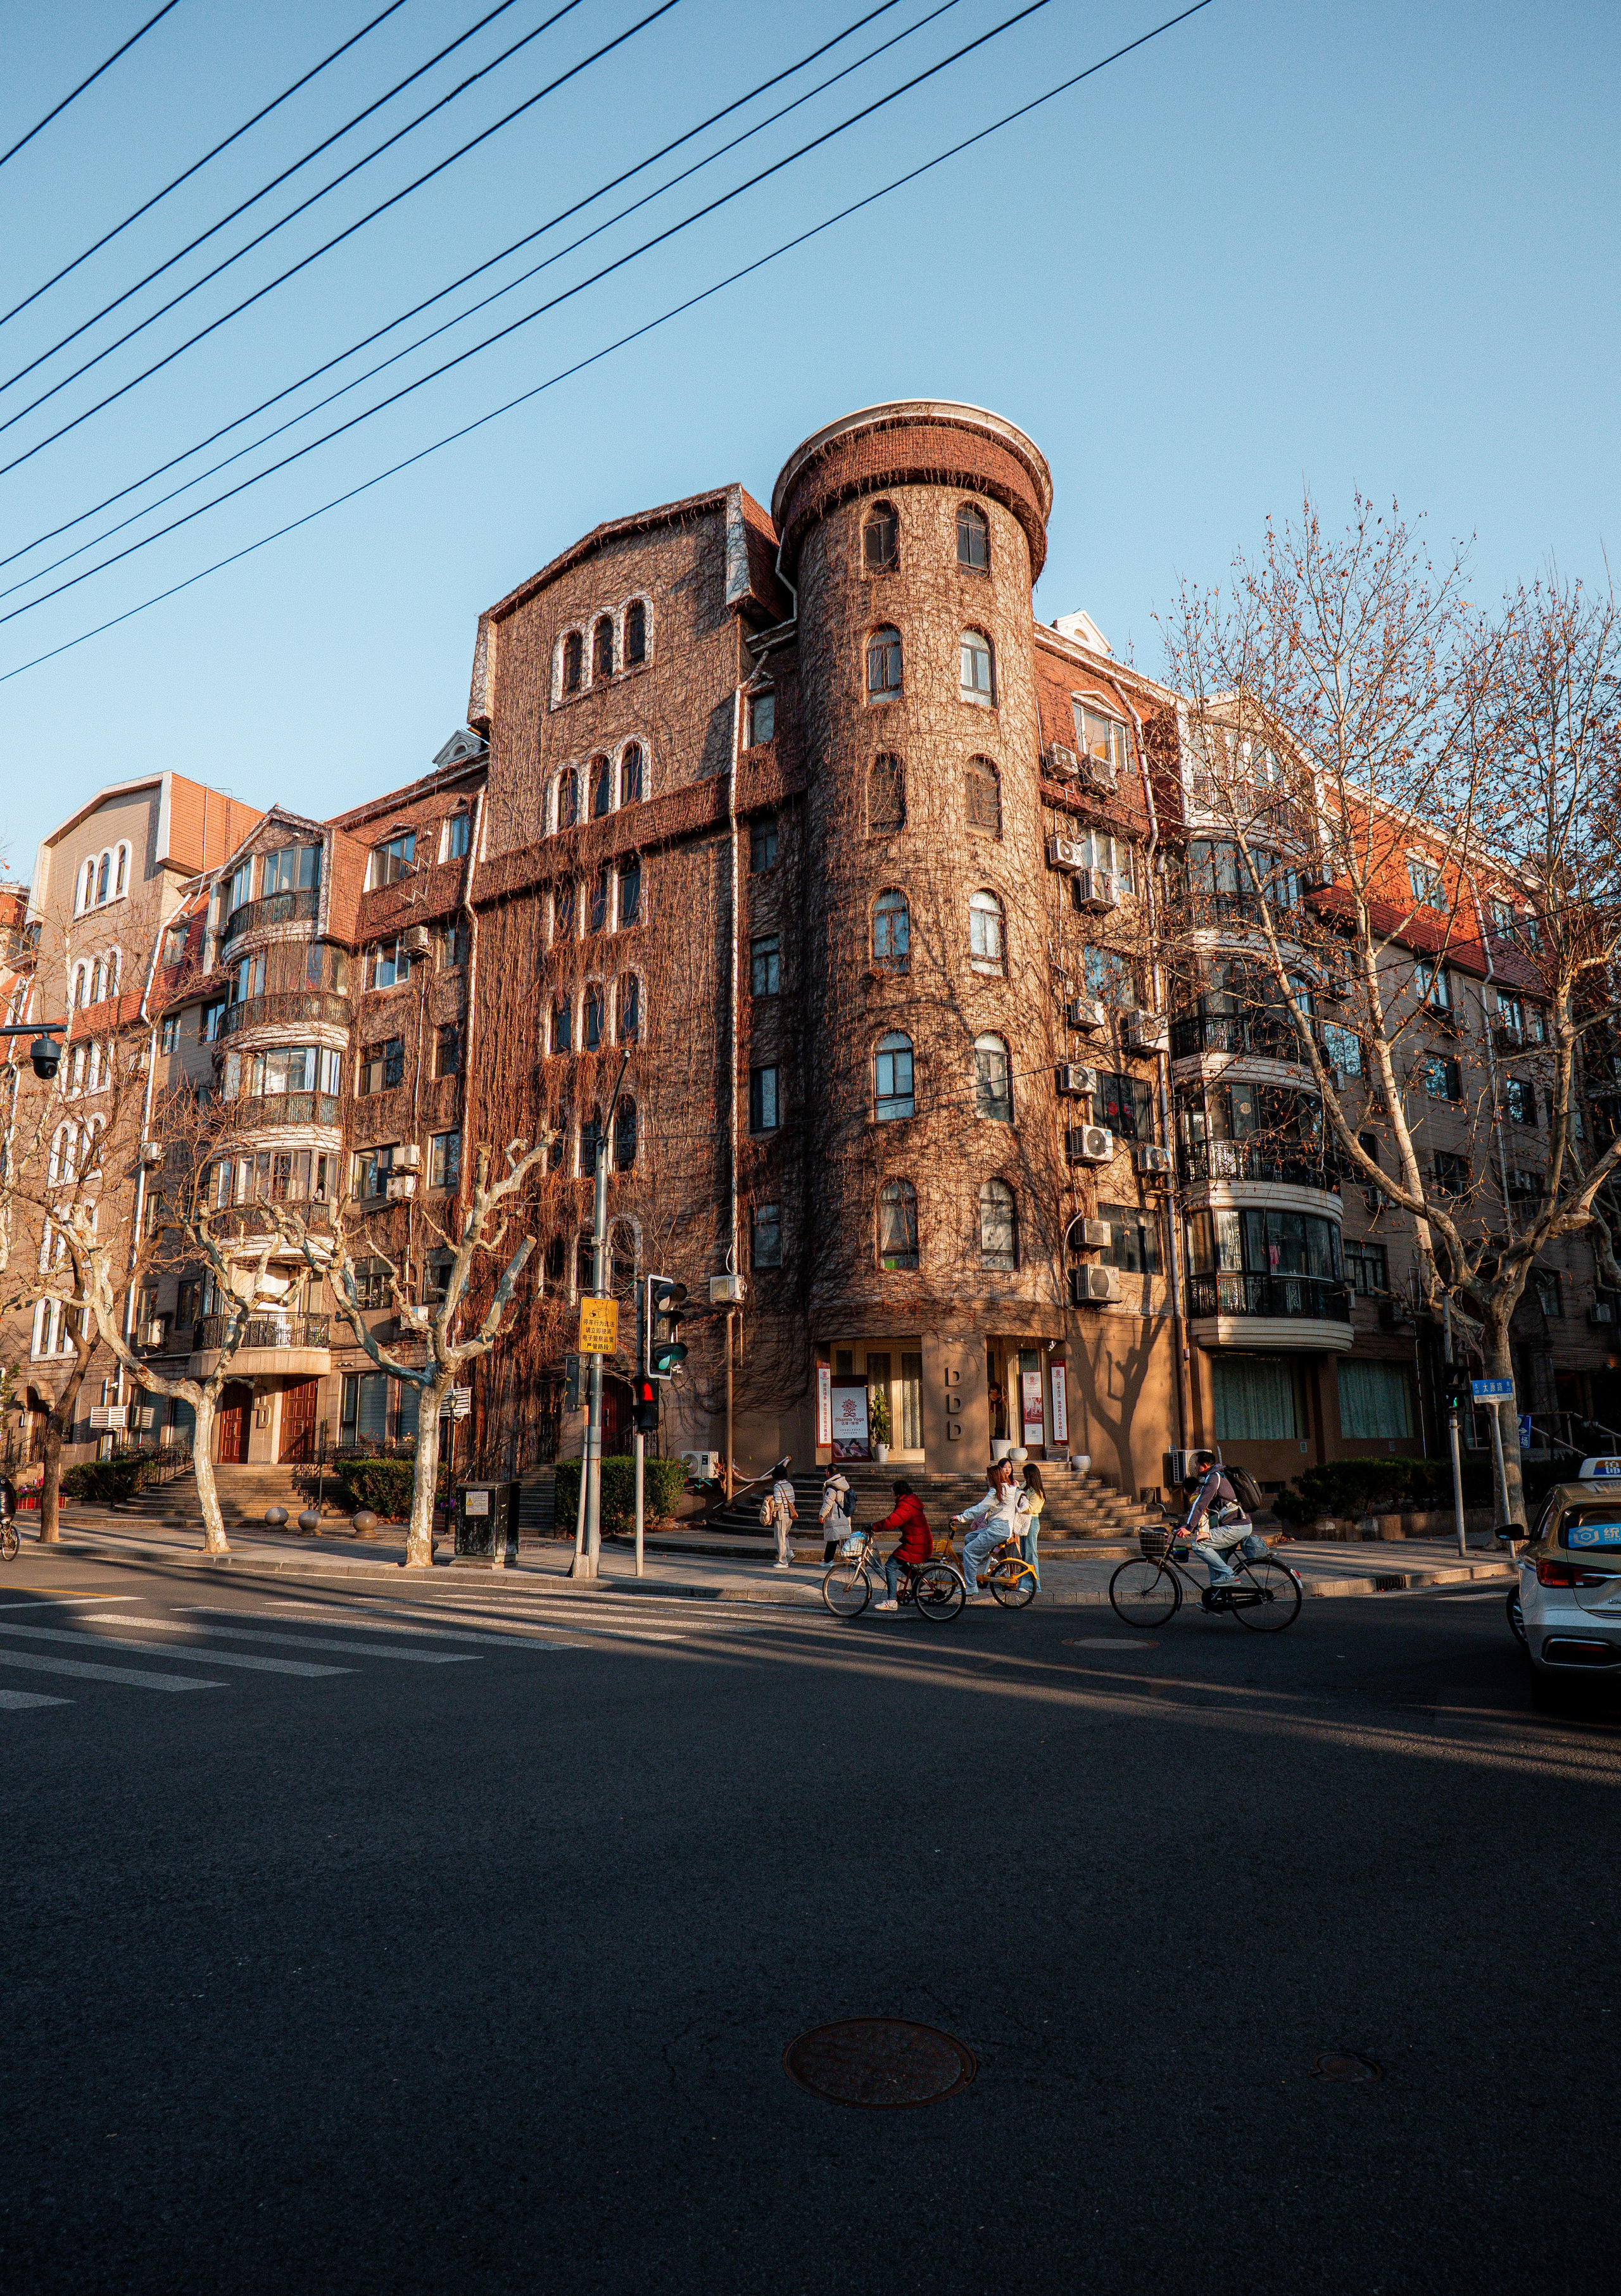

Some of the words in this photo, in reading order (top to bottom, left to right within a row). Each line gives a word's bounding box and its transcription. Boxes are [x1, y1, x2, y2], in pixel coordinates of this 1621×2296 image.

[583, 1334, 614, 1343] 电子警察监管
[1482, 1383, 1503, 1393] 太原路
[1605, 1460, 1621, 1474] 锦
